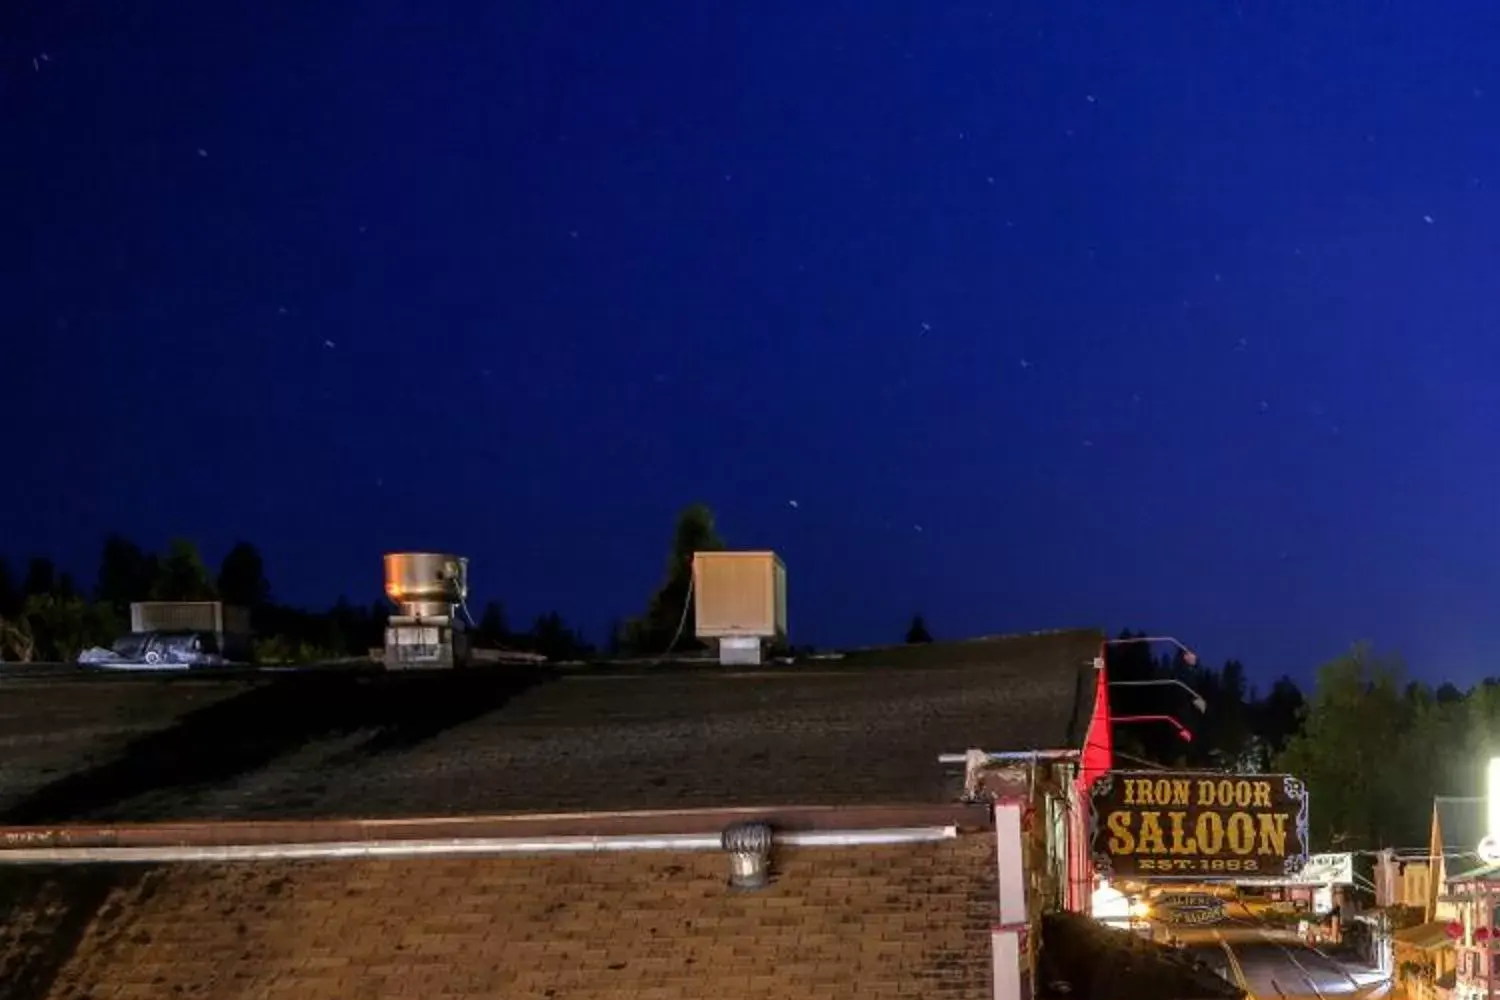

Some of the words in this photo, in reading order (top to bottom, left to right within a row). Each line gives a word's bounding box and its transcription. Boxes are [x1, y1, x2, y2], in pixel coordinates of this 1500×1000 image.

[1123, 779, 1191, 805] IRON
[1197, 780, 1272, 808] DOOR
[1107, 810, 1289, 857] SALOON
